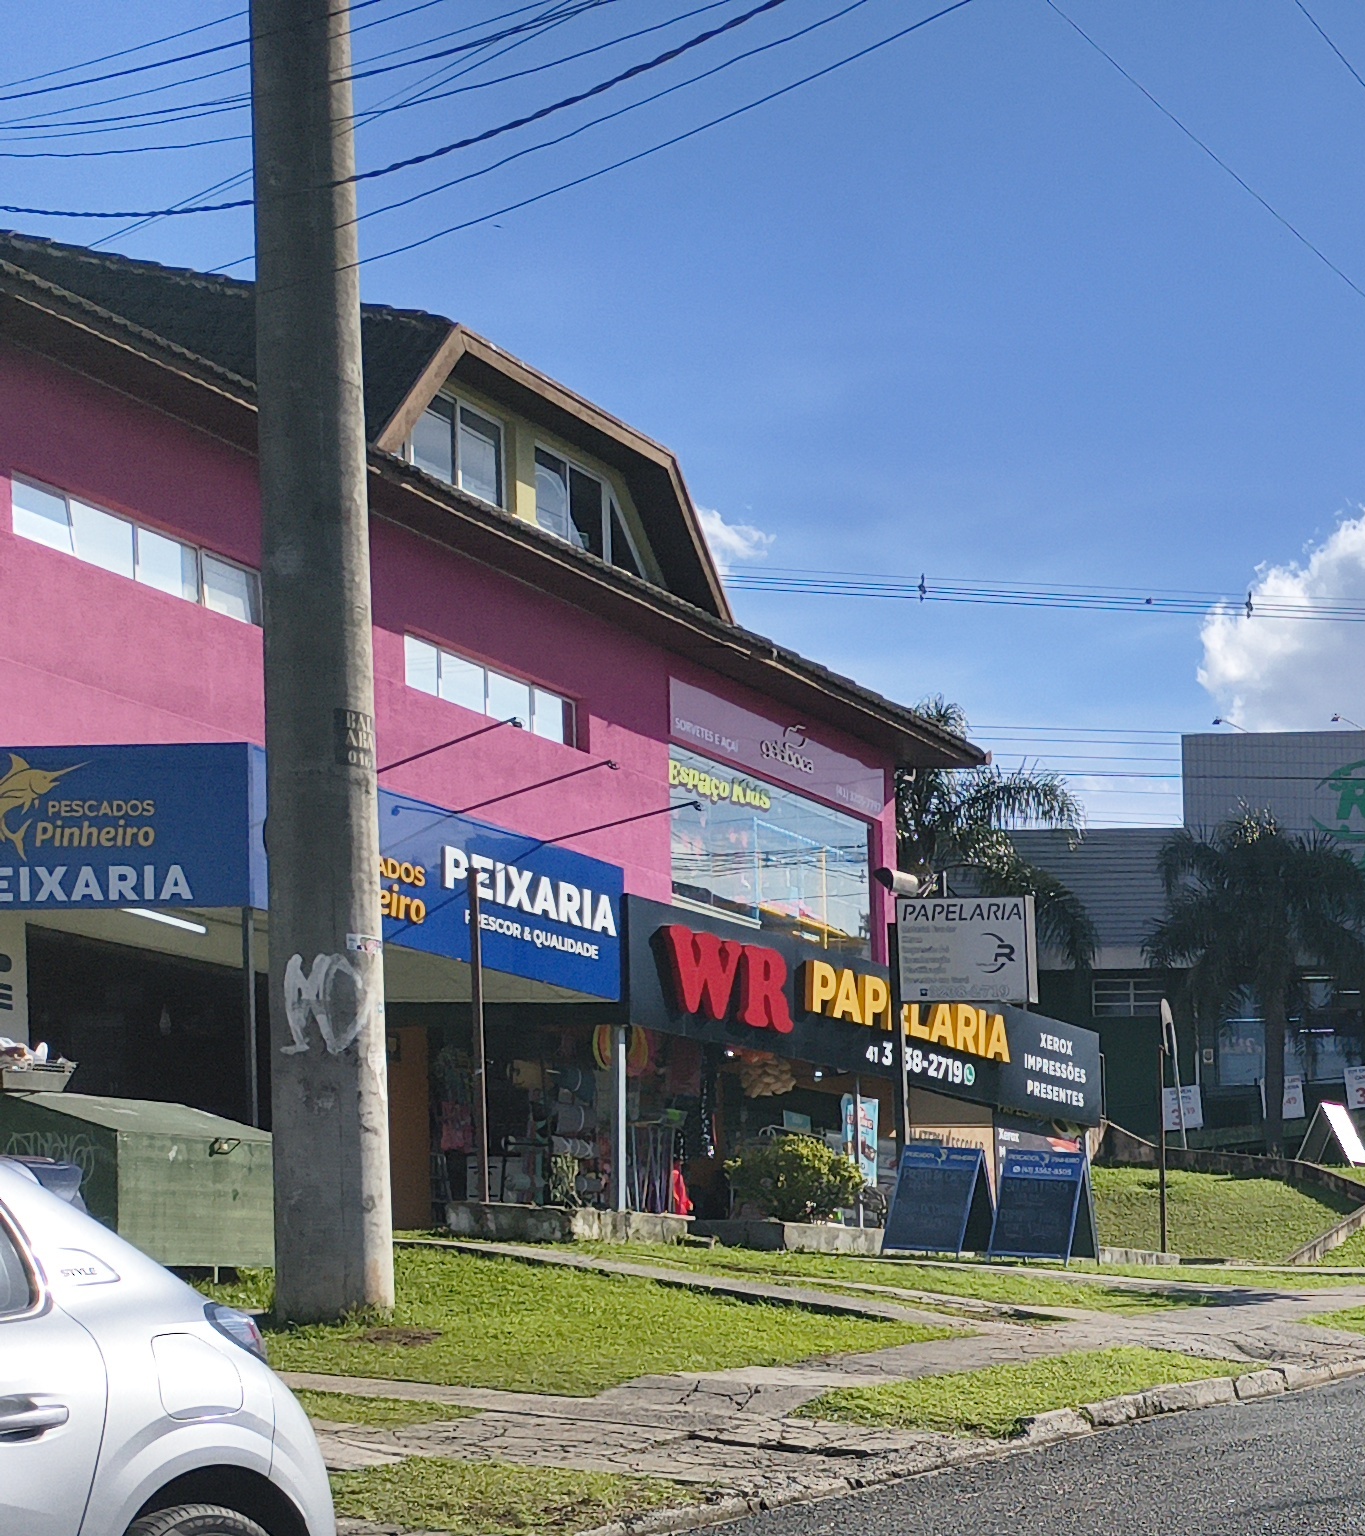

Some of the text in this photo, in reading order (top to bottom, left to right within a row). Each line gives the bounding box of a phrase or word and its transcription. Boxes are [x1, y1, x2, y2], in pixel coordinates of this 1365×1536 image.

[675, 717, 739, 753] SORVETES E AÇAÍ
[669, 759, 771, 810] Espaço Kids
[47, 800, 155, 817] PESCADOS
[35, 820, 155, 848] Pinheiro
[444, 844, 618, 937] PEIXARIA
[902, 902, 1022, 922] PAPELARIA
[464, 909, 599, 960] FESCOR & QUALIDADE
[665, 923, 795, 1034] WR
[1039, 1032, 1073, 1057] XEROX
[865, 1040, 963, 1085] 41 338-2719
[1024, 1052, 1087, 1085] IMPRESSÕES
[1026, 1080, 1084, 1108] PRESENTES
[999, 1127, 1020, 1143] Xerox
